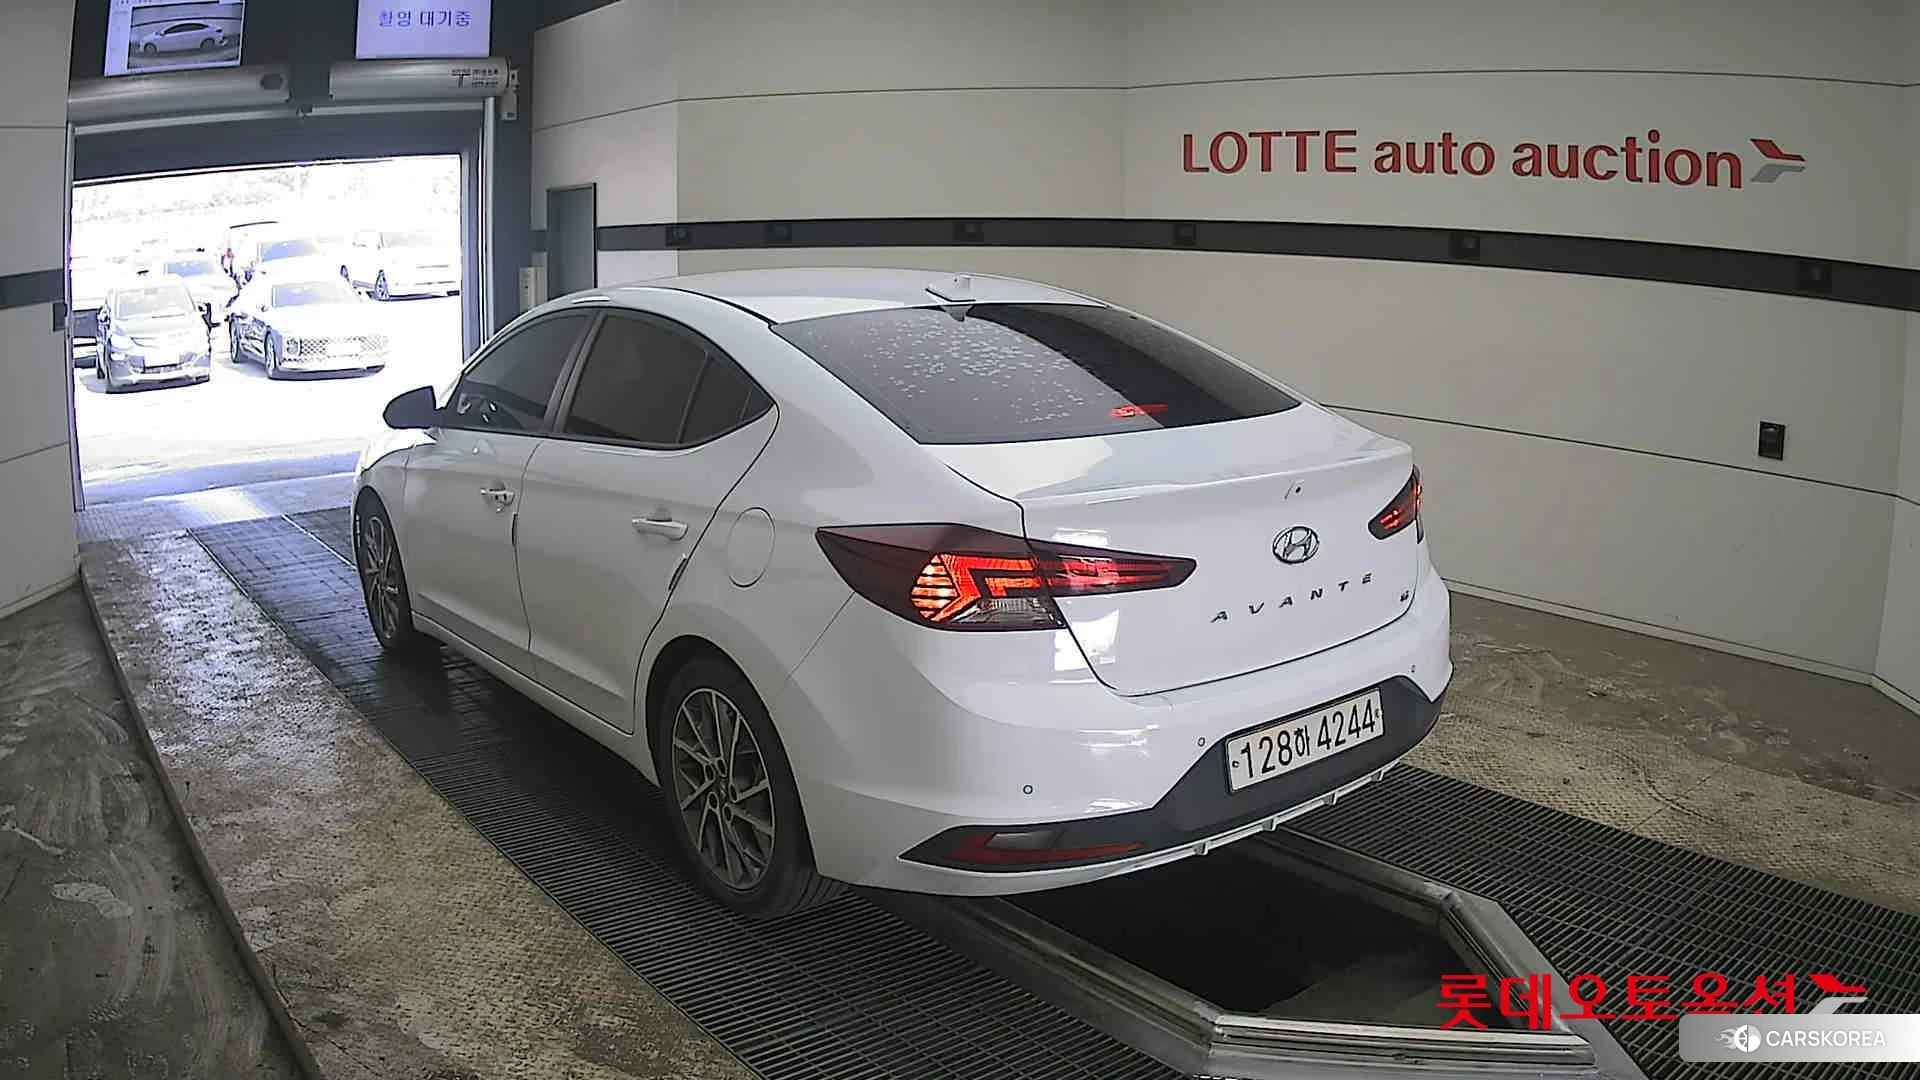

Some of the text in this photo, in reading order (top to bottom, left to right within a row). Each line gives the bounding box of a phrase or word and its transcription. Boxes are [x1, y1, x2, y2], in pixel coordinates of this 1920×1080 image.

[419, 10, 472, 28] 대기중
[1183, 129, 1743, 189] LOTTE auto auction
[1209, 573, 1373, 624] AVANTE
[1240, 698, 1376, 778] 128하 4244
